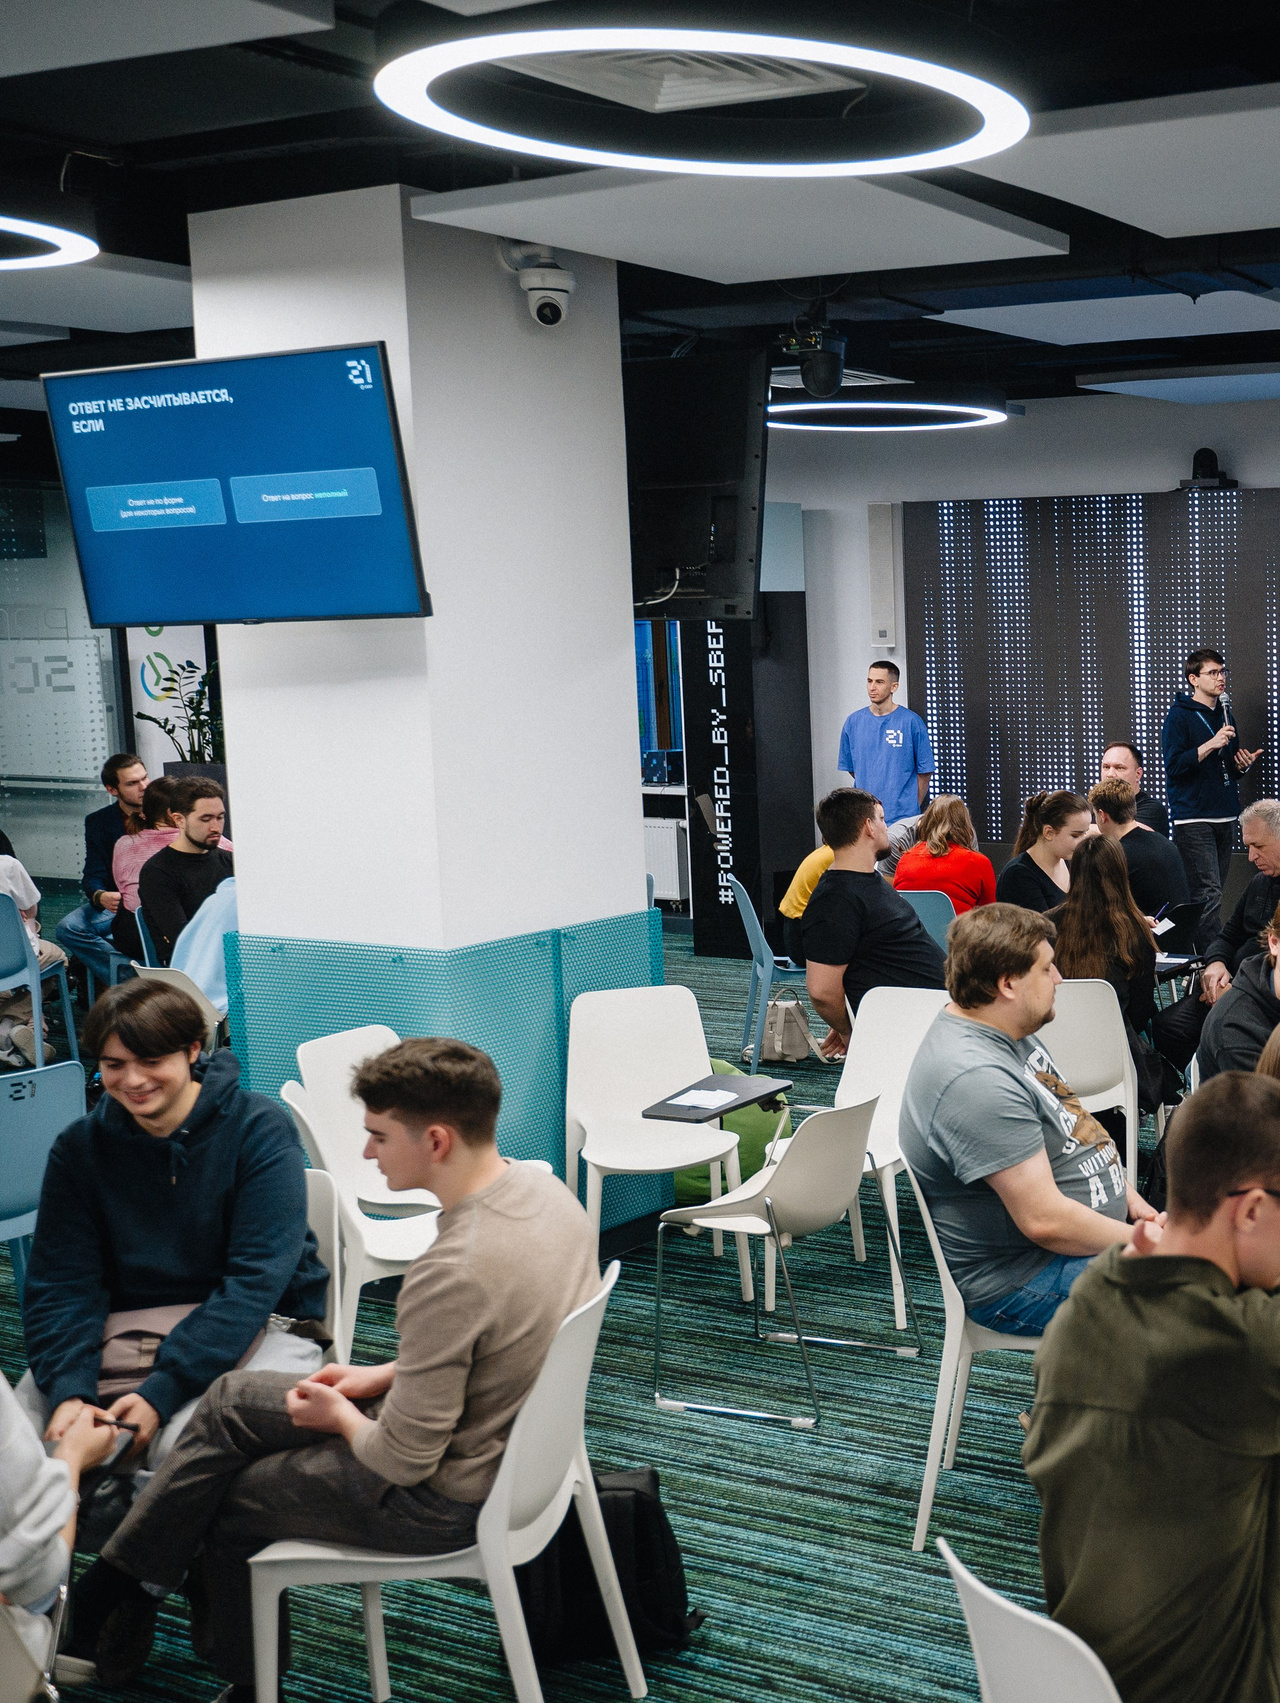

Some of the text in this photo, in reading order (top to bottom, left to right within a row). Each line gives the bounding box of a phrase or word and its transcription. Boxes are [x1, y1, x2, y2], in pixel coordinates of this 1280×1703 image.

[68, 388, 234, 415] ОТВЕТ НЕ ЗАСЧИТЫВАЕТСЯ,
[72, 418, 105, 434] ЕСЛИ
[1088, 1163, 1125, 1209] A B
